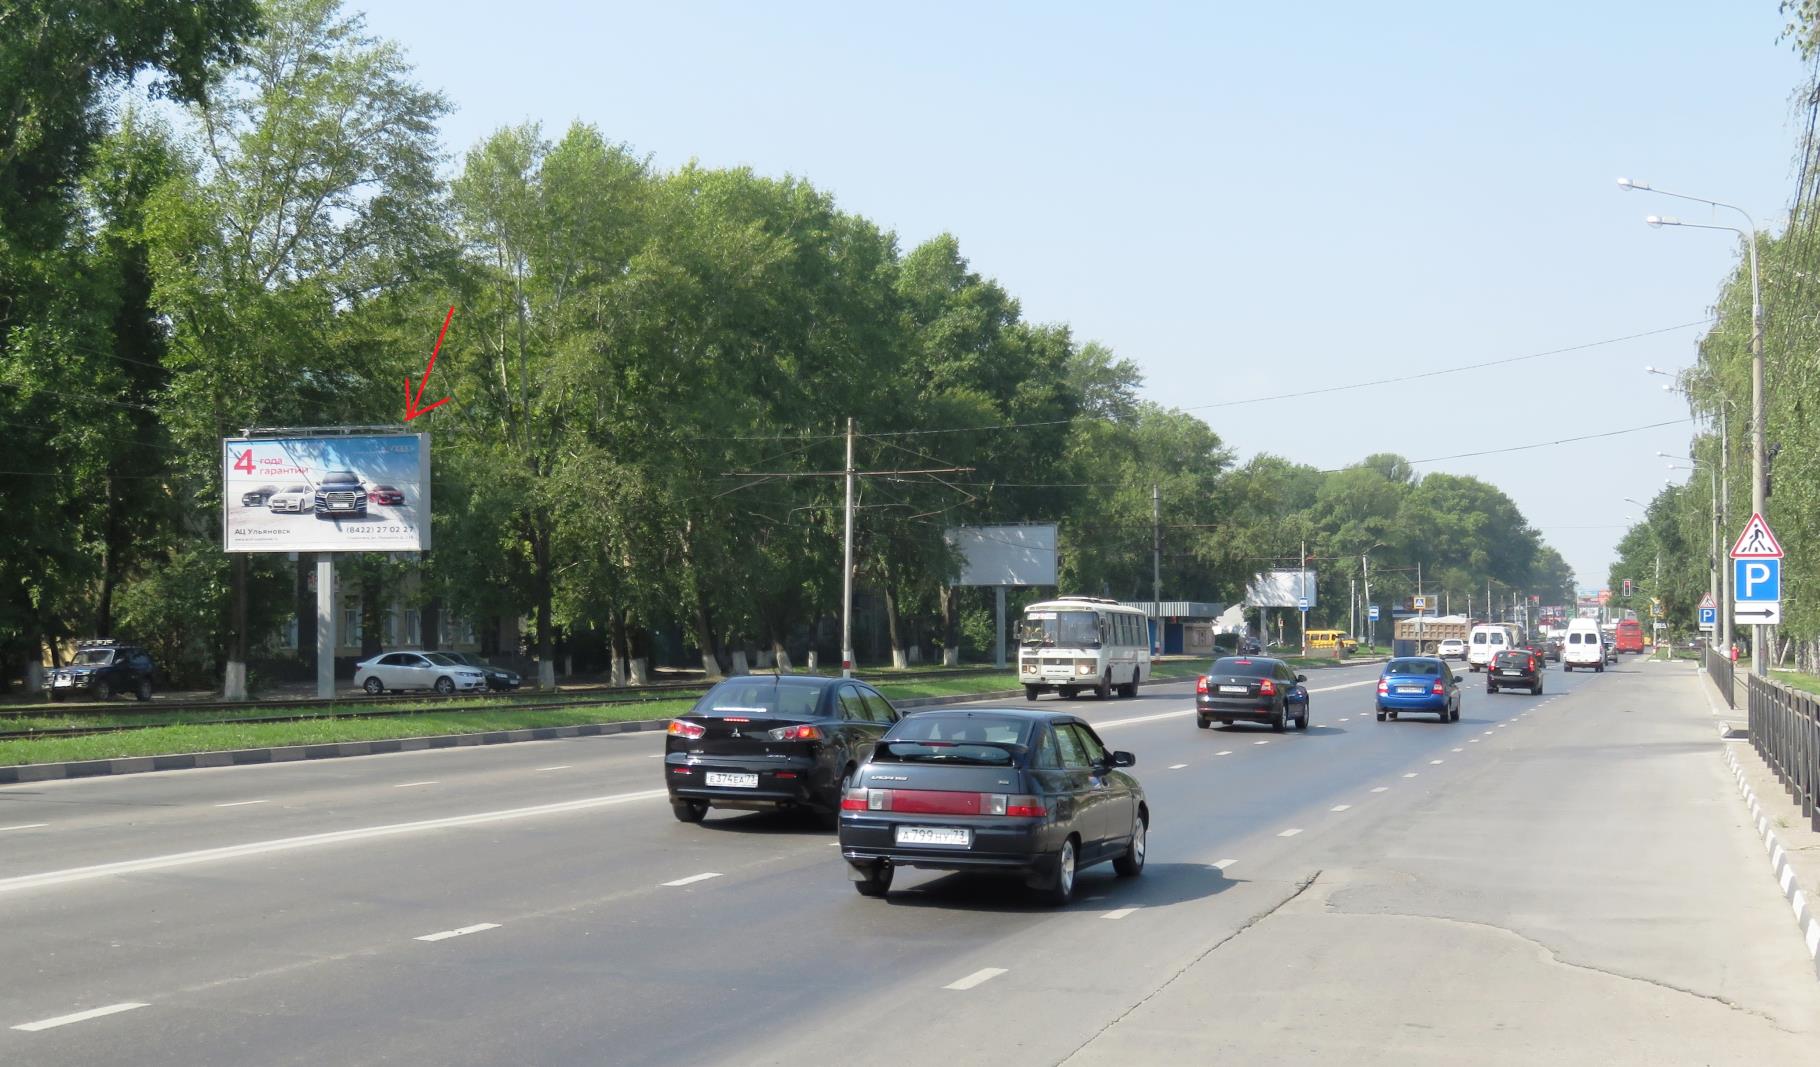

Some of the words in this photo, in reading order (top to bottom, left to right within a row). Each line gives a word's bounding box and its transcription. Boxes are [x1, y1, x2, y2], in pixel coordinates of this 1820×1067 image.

[234, 449, 256, 475] 4
[260, 467, 309, 476] гарантии
[1745, 563, 1770, 597] P
[1703, 609, 1713, 621] P
